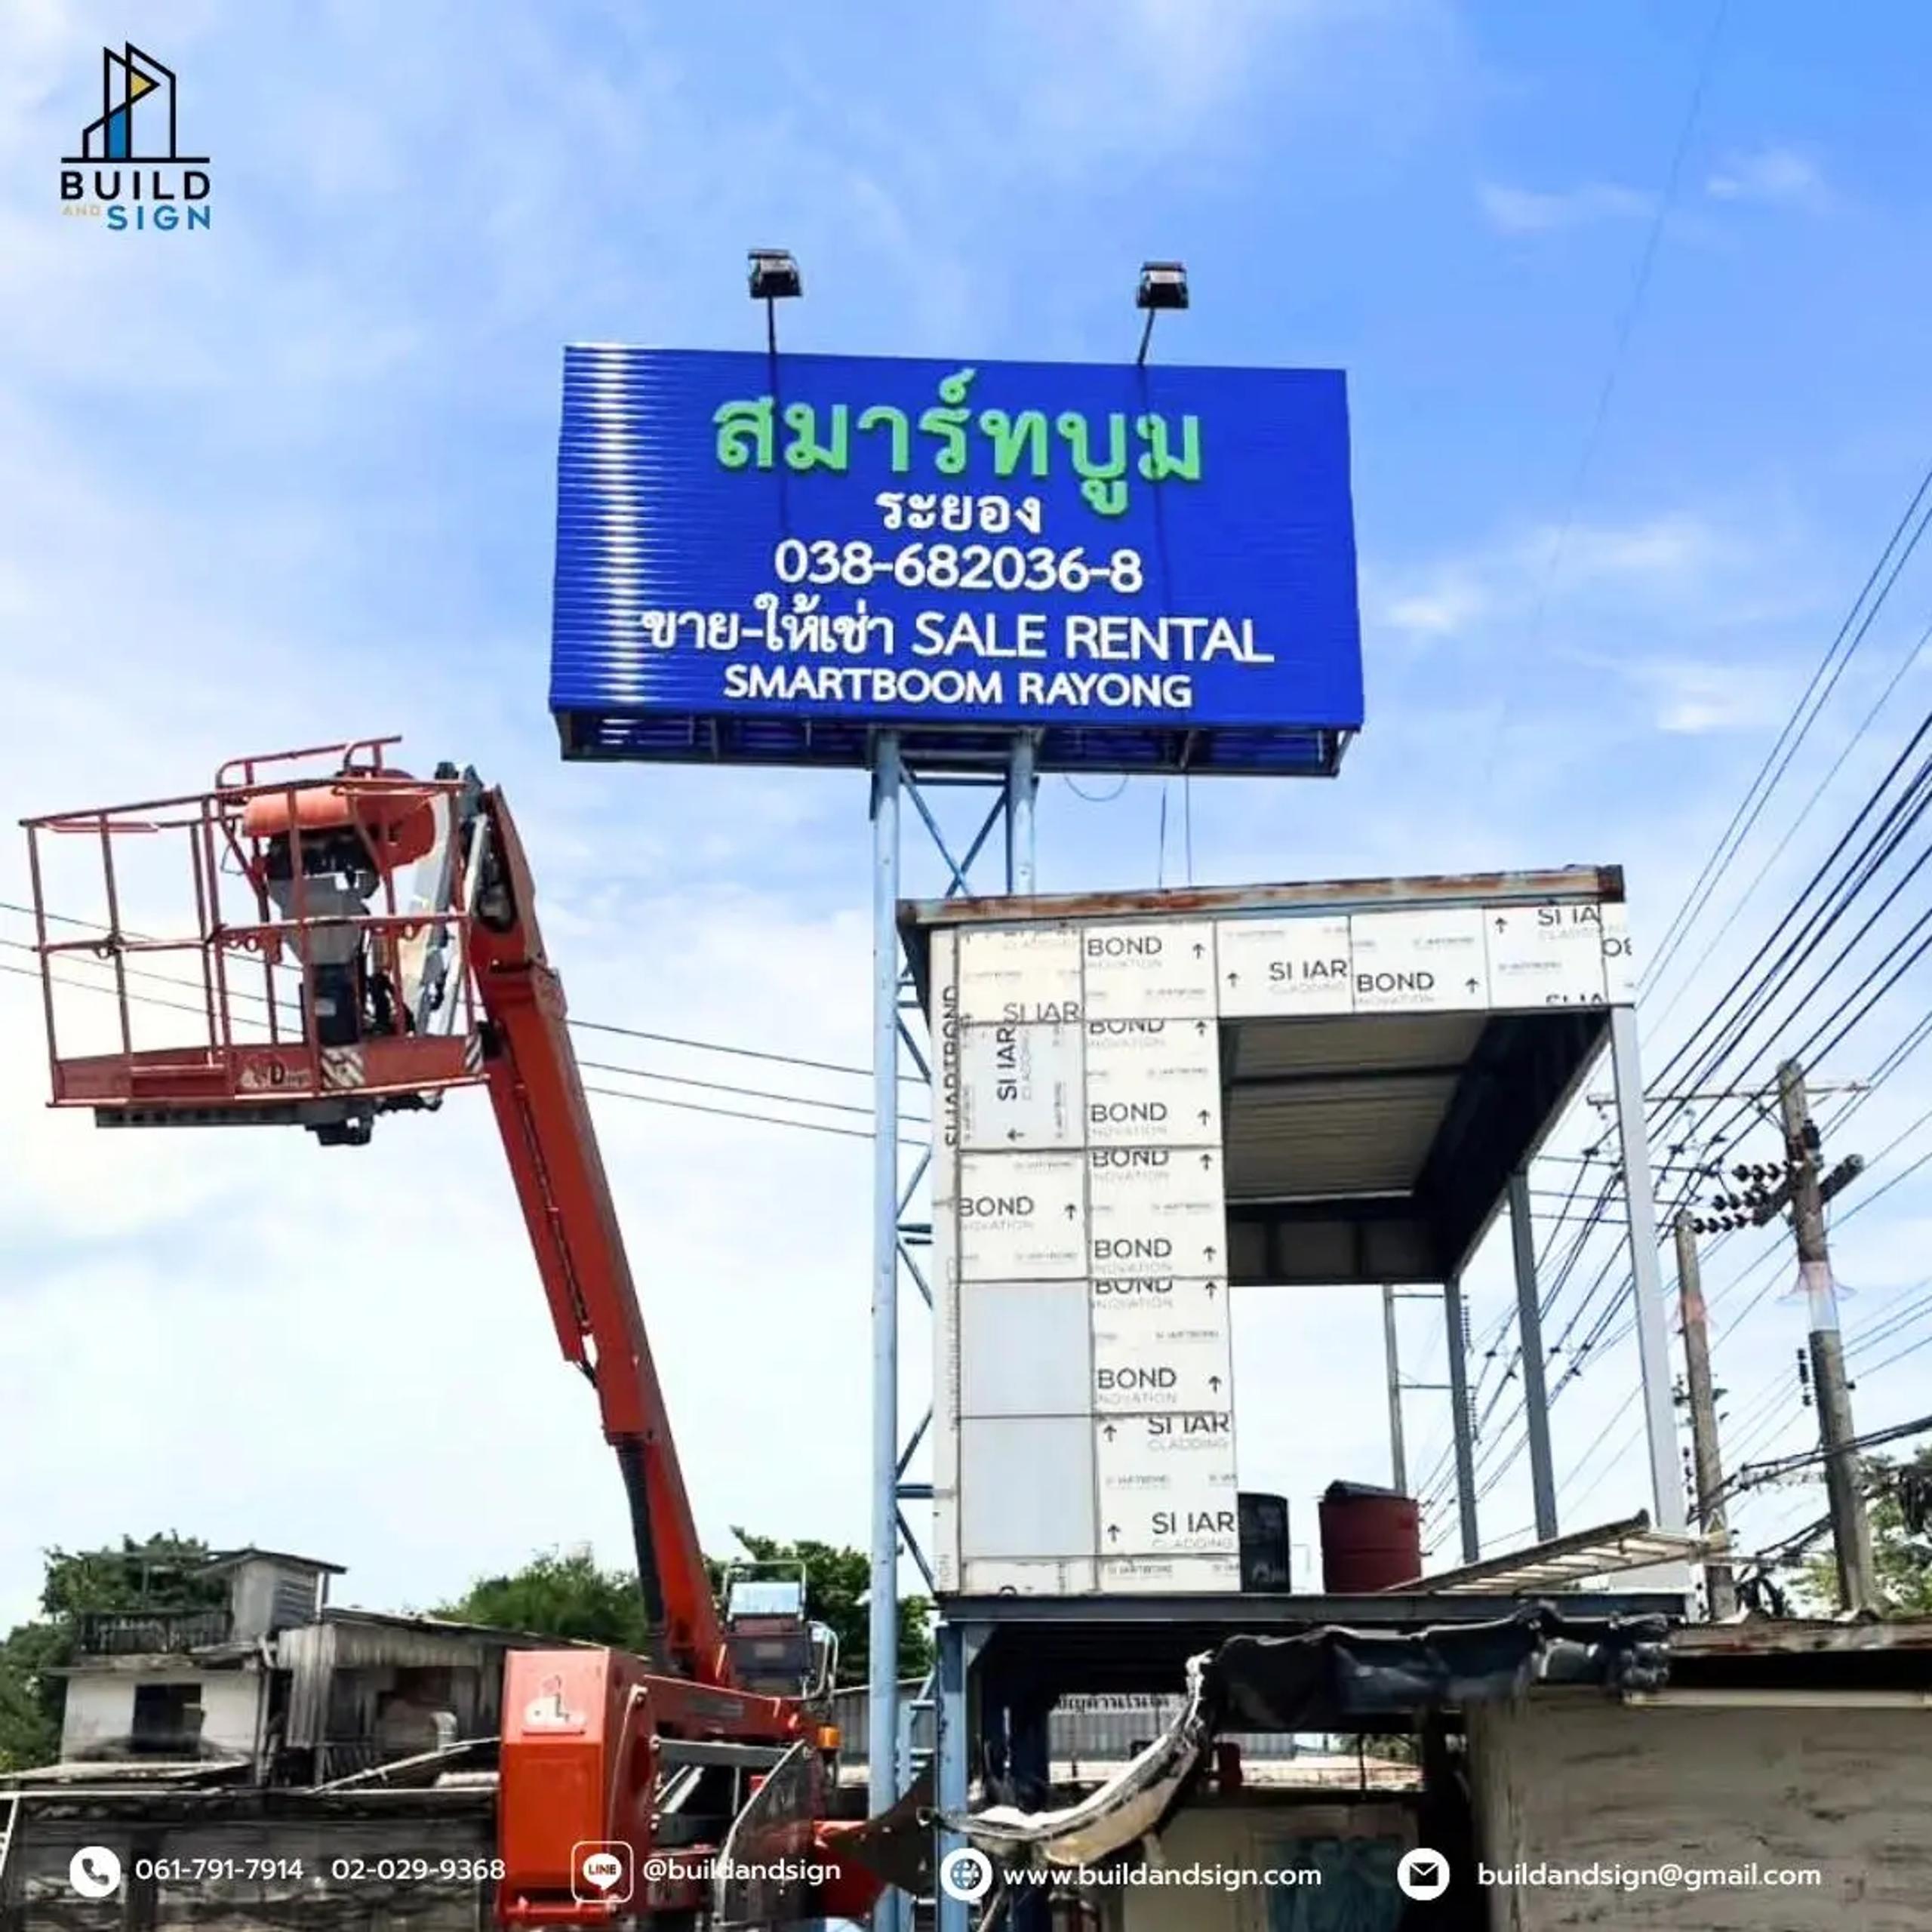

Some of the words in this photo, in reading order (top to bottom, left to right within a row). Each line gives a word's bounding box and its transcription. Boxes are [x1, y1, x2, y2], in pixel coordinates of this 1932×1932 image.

[712, 368, 1203, 516] สมาร์ทบูม
[875, 492, 1041, 534] ระยอง
[773, 539, 1143, 593] 038-682036-8
[641, 592, 895, 655] ขาย-ให้เช่า
[912, 611, 1047, 657] SALE
[1066, 615, 1275, 663] RENTAL
[723, 663, 1004, 703] SMARTBOOM
[1019, 672, 1193, 708] RAYONG
[1088, 936, 1163, 956] BOND
[1357, 972, 1435, 993] BOND
[1091, 1102, 1168, 1123] BOND
[1093, 1149, 1171, 1168] BOND
[958, 1195, 1035, 1217] BOND
[1094, 1238, 1173, 1260] BOND
[1097, 1366, 1177, 1389] BOND
